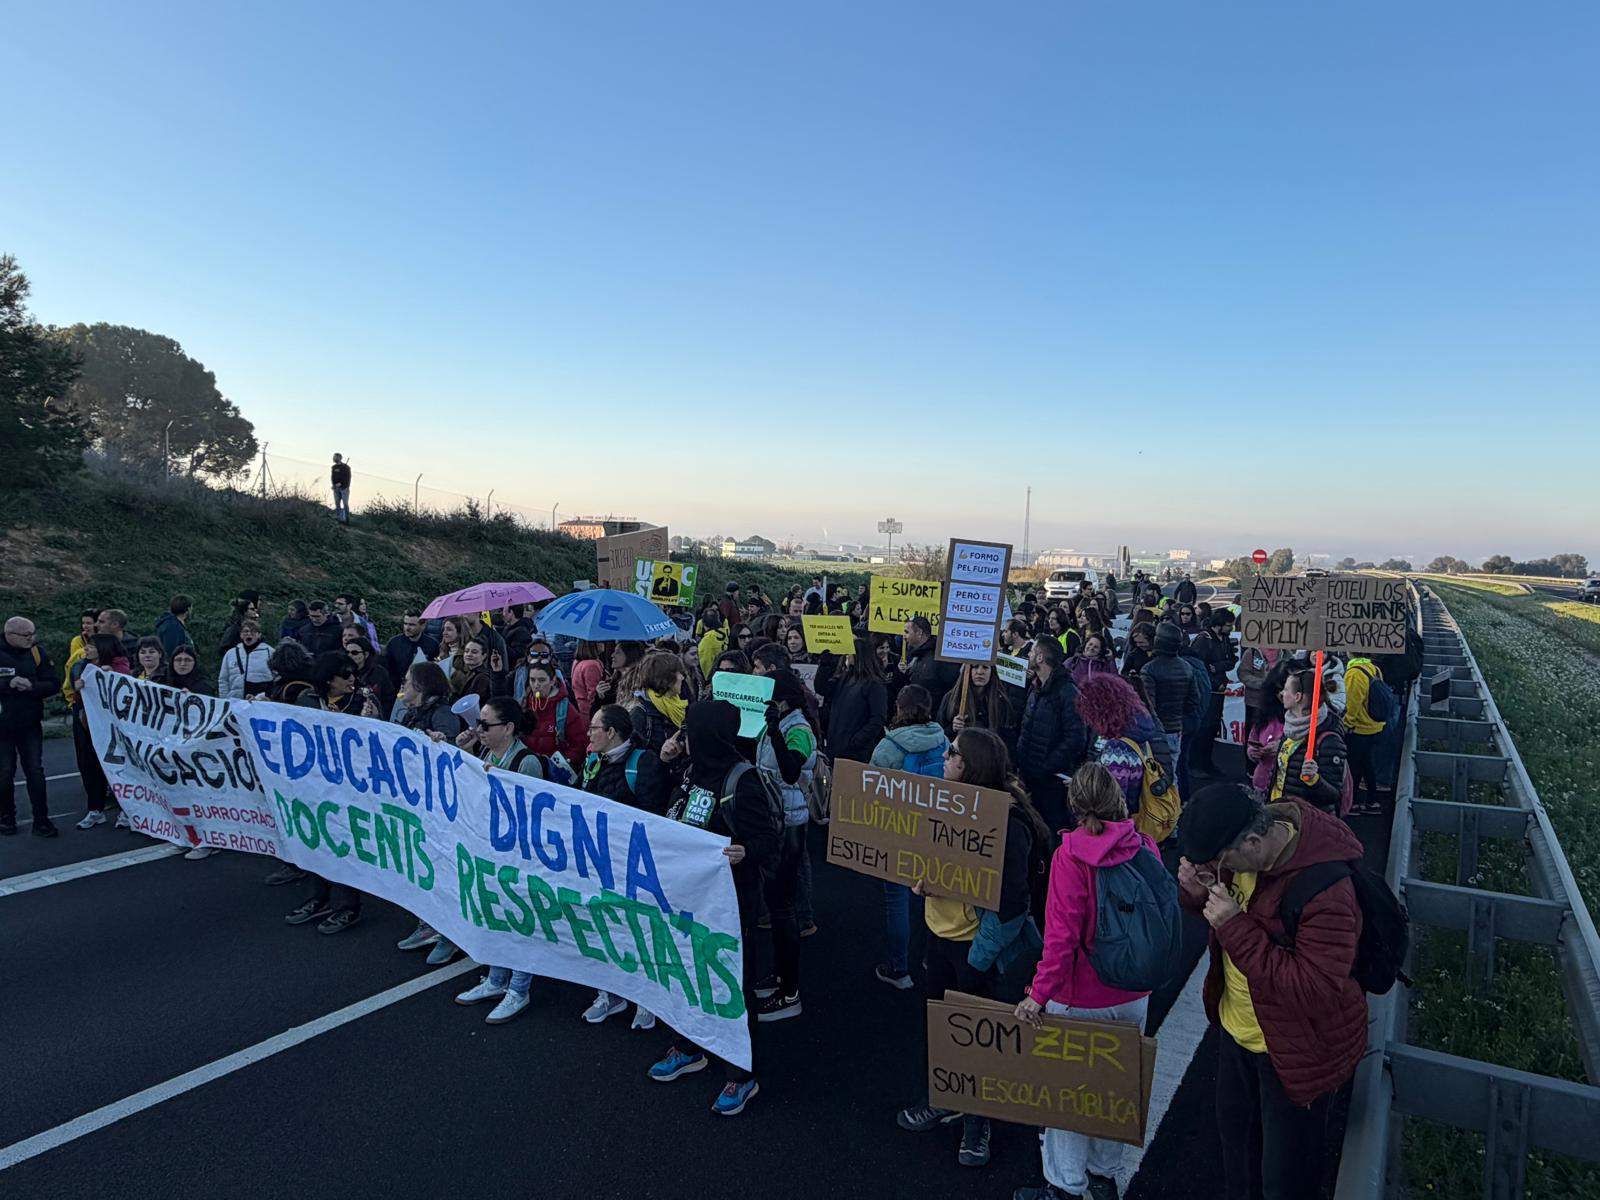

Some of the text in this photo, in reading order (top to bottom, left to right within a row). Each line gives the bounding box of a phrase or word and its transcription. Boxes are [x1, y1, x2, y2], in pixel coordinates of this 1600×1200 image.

[969, 551, 1000, 562] FORMO
[957, 563, 999, 575] PEL FUTUR
[892, 582, 938, 598] SUPORT
[955, 589, 992, 601] PERÒ EL
[1252, 577, 1297, 599] AVUI
[1327, 579, 1405, 602] FOTEU LOS
[874, 606, 884, 621] A
[889, 608, 910, 622] LES
[951, 603, 993, 615] MEU SOU
[1326, 600, 1406, 622] PELS INFANTS
[950, 626, 979, 639] ÉS DEL
[1244, 619, 1309, 646] OMPLIM
[1325, 621, 1405, 649] ELS CARRERS
[946, 641, 980, 651] PASSAT!
[250, 717, 464, 823] EDUCACIÓ
[691, 795, 712, 809] JO
[132, 815, 276, 855] SALARIS LES RÀTIOS
[838, 795, 998, 858] LLUITANT TAMBÉ
[831, 835, 999, 901] ESTEM EDUCANT
[273, 788, 746, 1020] DOCENTS RESPECTATS
[947, 1012, 1126, 1073] SOM ZER
[932, 1066, 1140, 1125] SOM ESCOLA PÚBLICA
